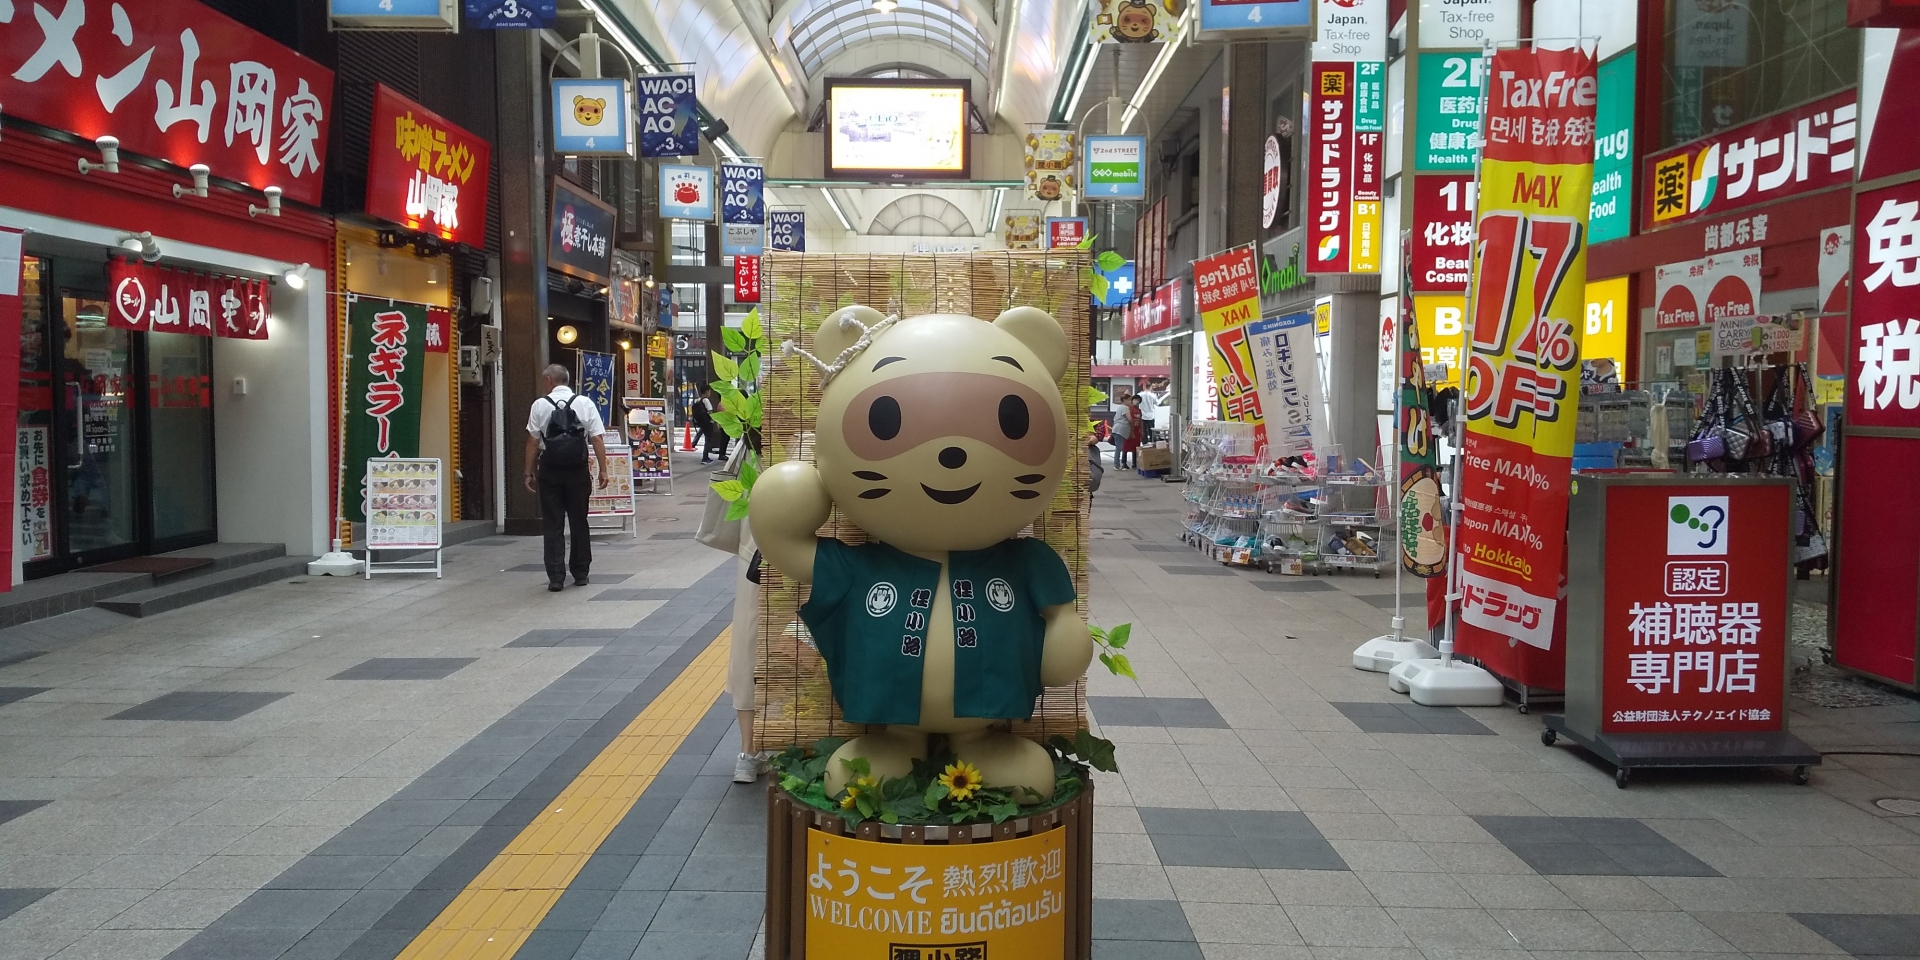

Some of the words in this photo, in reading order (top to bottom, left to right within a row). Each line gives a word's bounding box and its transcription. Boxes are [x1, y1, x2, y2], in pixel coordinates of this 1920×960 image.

[1247, 6, 1262, 22] 4
[1327, 14, 1368, 27] Japan.
[1440, 10, 1494, 23] Tax-free
[1324, 29, 1370, 40] Tax-free
[1449, 26, 1484, 40] Shop
[1332, 43, 1361, 56] Shop
[1361, 63, 1380, 75] 2F
[1442, 57, 1491, 88] 2F
[0, 0, 323, 178] メン山岡家
[641, 79, 693, 94] WAO!
[1323, 74, 1342, 93] 薬
[643, 97, 674, 114] AC
[643, 116, 676, 133] AO
[1452, 118, 1479, 129] Drug
[1490, 116, 1526, 143] 면세
[396, 111, 475, 185] 味噌ラーメン
[585, 137, 595, 147] 4
[1360, 134, 1378, 145] 1F
[1429, 132, 1484, 150] 健康食
[1594, 128, 1629, 160] rug
[1319, 100, 1343, 231] サンドラッグ
[1363, 153, 1373, 183] 化妆品
[1428, 154, 1468, 163] Health
[723, 167, 761, 180] WAO!
[1112, 168, 1138, 177] mobile
[724, 180, 748, 193] AC
[1110, 184, 1118, 193] 4
[1592, 170, 1622, 196] ealth
[1656, 161, 1685, 216] 薬
[406, 169, 458, 230] 山岡家
[725, 194, 749, 207] AO
[1358, 204, 1376, 215] B1
[683, 207, 691, 215] 4
[772, 213, 803, 223] WAO!
[728, 228, 757, 236] こぶしや
[773, 224, 791, 234] AC
[1424, 222, 1473, 246] 化妆
[1704, 214, 1769, 252] 尚都乐客
[773, 235, 792, 245] AO
[1436, 257, 1473, 270] Beau
[739, 255, 749, 297] こぶしや
[1271, 256, 1307, 294] mobil
[1426, 271, 1475, 283] Cosm
[1858, 199, 1920, 411] 免税
[1435, 307, 1462, 336] B
[1586, 300, 1613, 335] B1
[1720, 320, 1743, 329] MINI
[1718, 329, 1749, 339] CARRY
[1720, 339, 1740, 349] BAG
[365, 310, 409, 459] ネギラー
[627, 363, 638, 390] 根室
[1206, 356, 1218, 420] 売り下
[1466, 450, 1491, 471] Free
[31, 430, 49, 518] お先に食券を
[19, 431, 32, 545] お買い求め下さい
[1672, 567, 1721, 592] 認定
[954, 580, 977, 648] 狸小路
[1462, 578, 1542, 631] ドラッグ
[901, 588, 931, 657] 狸小路
[1628, 602, 1762, 646] 補聴器
[1627, 650, 1760, 694] 専門店
[1612, 708, 1771, 722] 公益財団法人テクノエイド協会
[809, 852, 933, 904] ようこそ
[942, 848, 1062, 898] 熱烈歡迎
[810, 893, 932, 934] WELCOME
[940, 889, 1062, 934] ยินดีต้อนรับ
